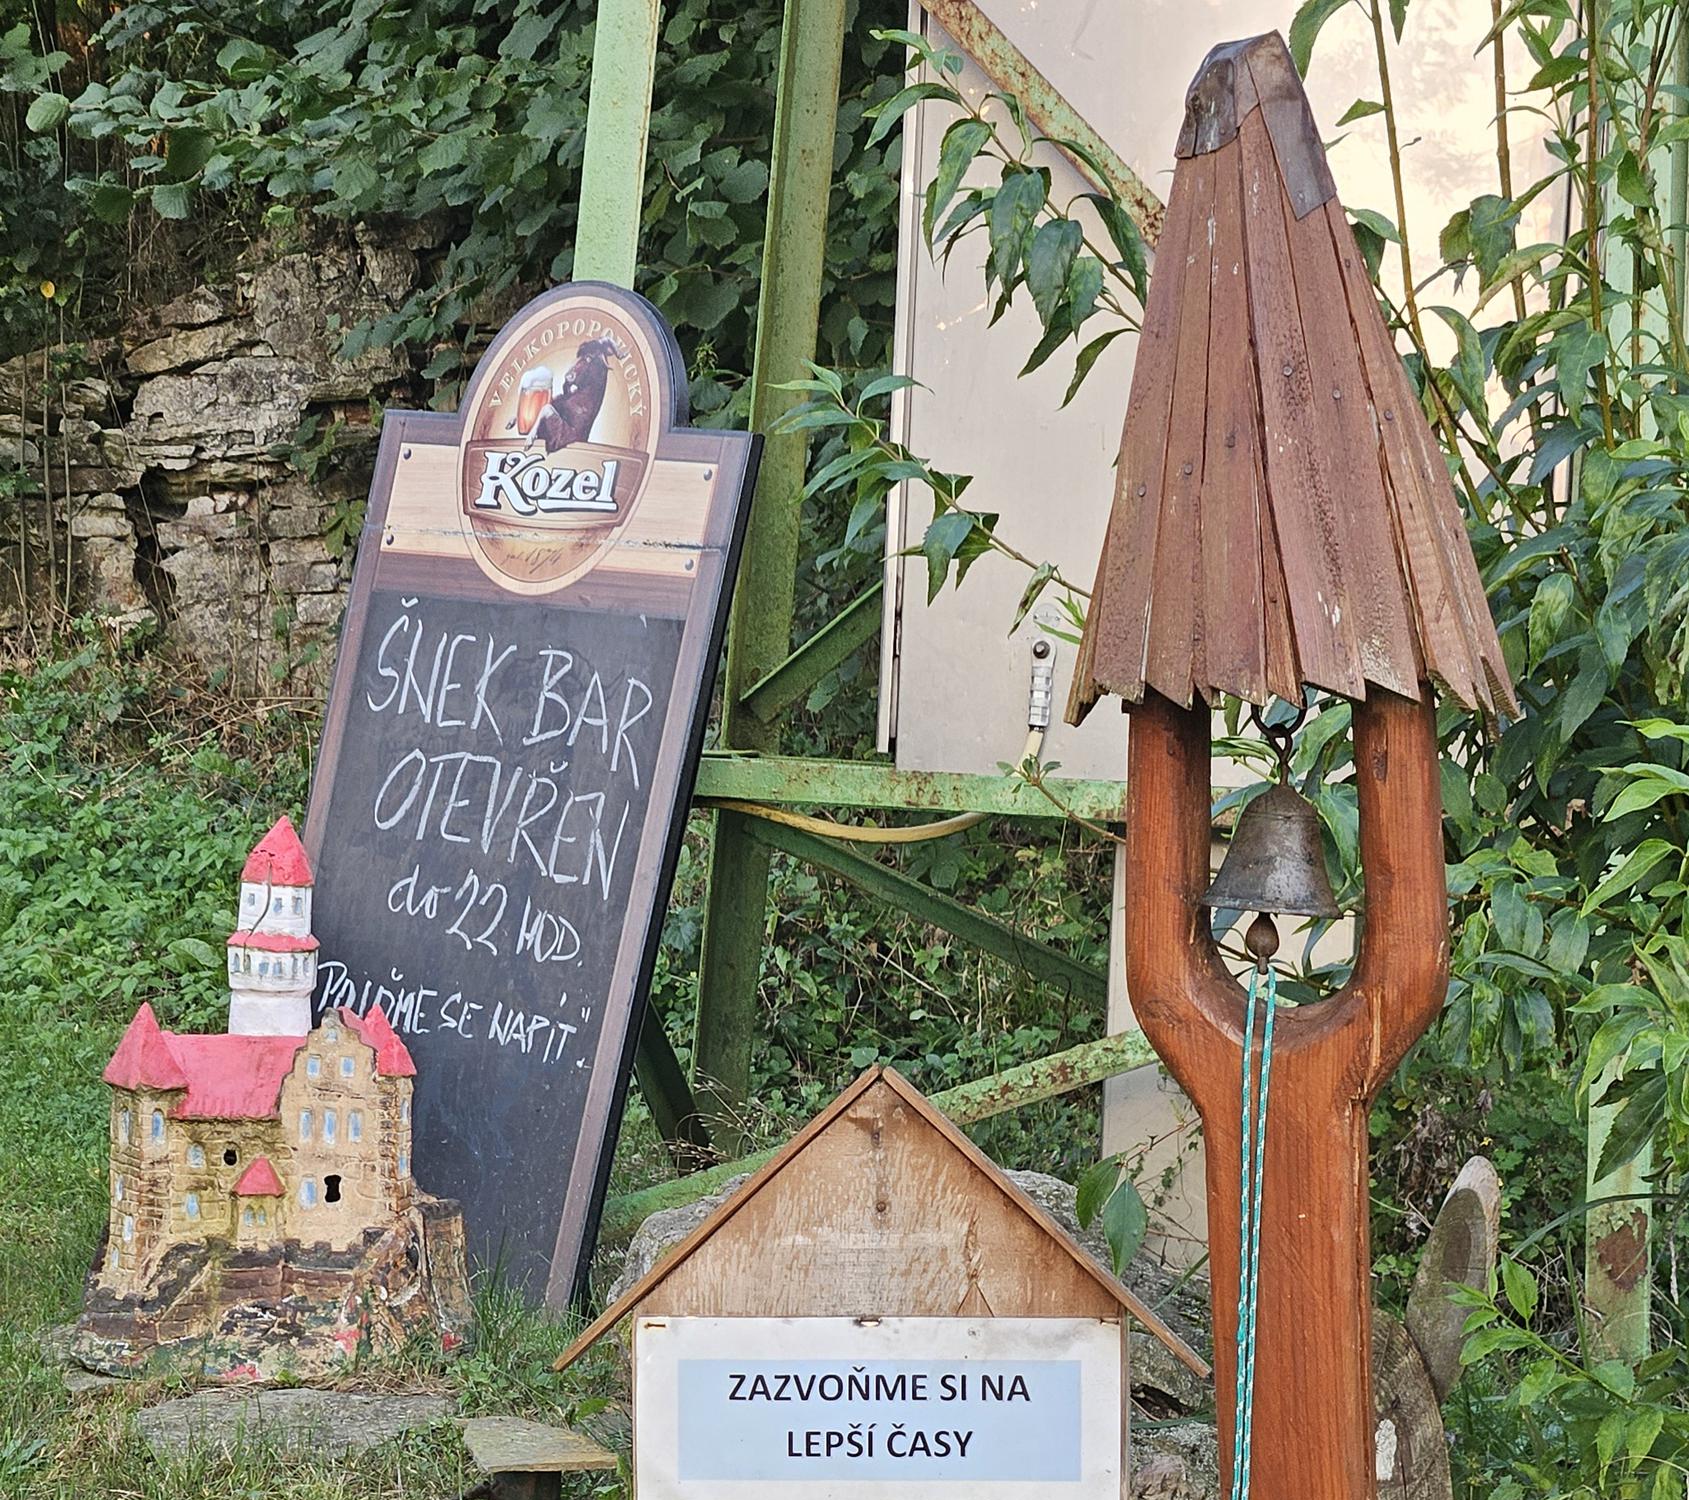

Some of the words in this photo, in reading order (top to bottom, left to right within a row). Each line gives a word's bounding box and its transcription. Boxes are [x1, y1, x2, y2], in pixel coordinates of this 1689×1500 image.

[474, 450, 620, 516] Kozel
[366, 596, 518, 746] ŠNEK
[522, 646, 653, 790] BAR
[374, 748, 630, 901] OTEVŘEN
[387, 864, 451, 920] do
[445, 868, 508, 956] 22
[515, 895, 583, 967] HOD.
[437, 991, 484, 1039] SE
[728, 1365, 927, 1402] ZAZVOŇME
[939, 1373, 968, 1402] SI
[981, 1373, 1031, 1402] NA
[786, 1422, 877, 1458] LEPŠÍ
[886, 1422, 974, 1458] ČASY
